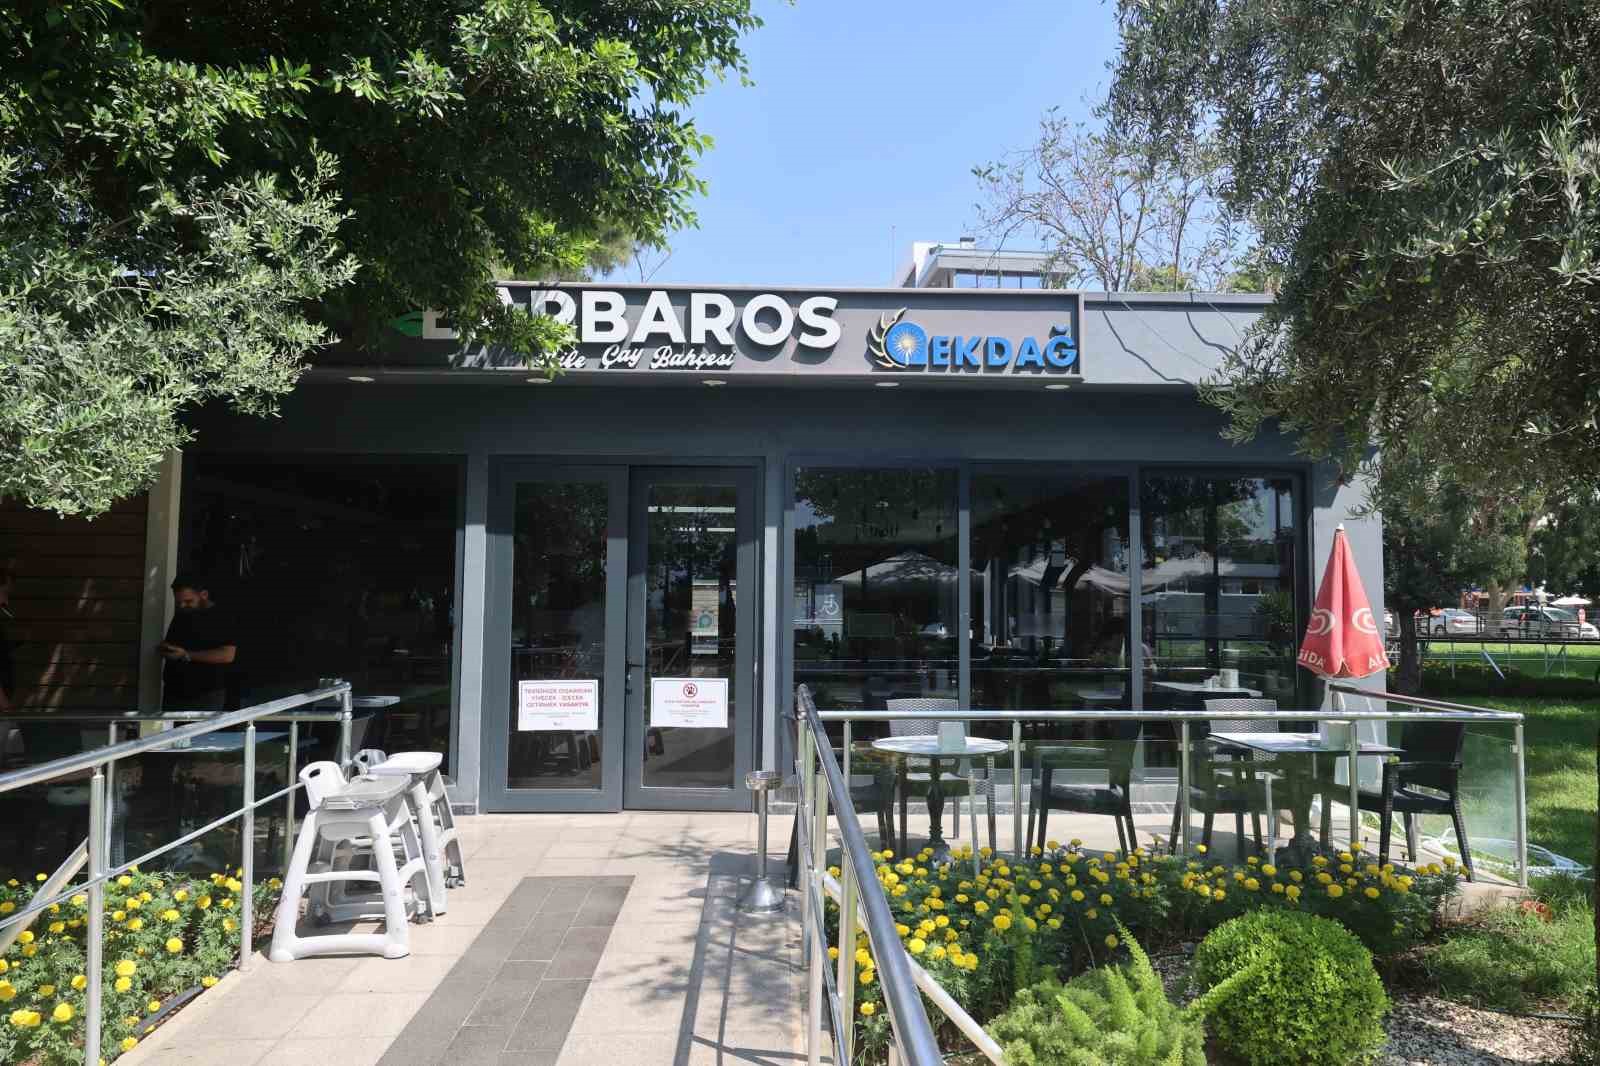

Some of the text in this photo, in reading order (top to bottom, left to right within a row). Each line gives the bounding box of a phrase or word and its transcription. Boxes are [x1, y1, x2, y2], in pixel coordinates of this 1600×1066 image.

[423, 288, 842, 349] RBAROS
[601, 344, 644, 369] Çay
[650, 345, 736, 370] Bahçesi
[931, 325, 1078, 367] EKDAĞ
